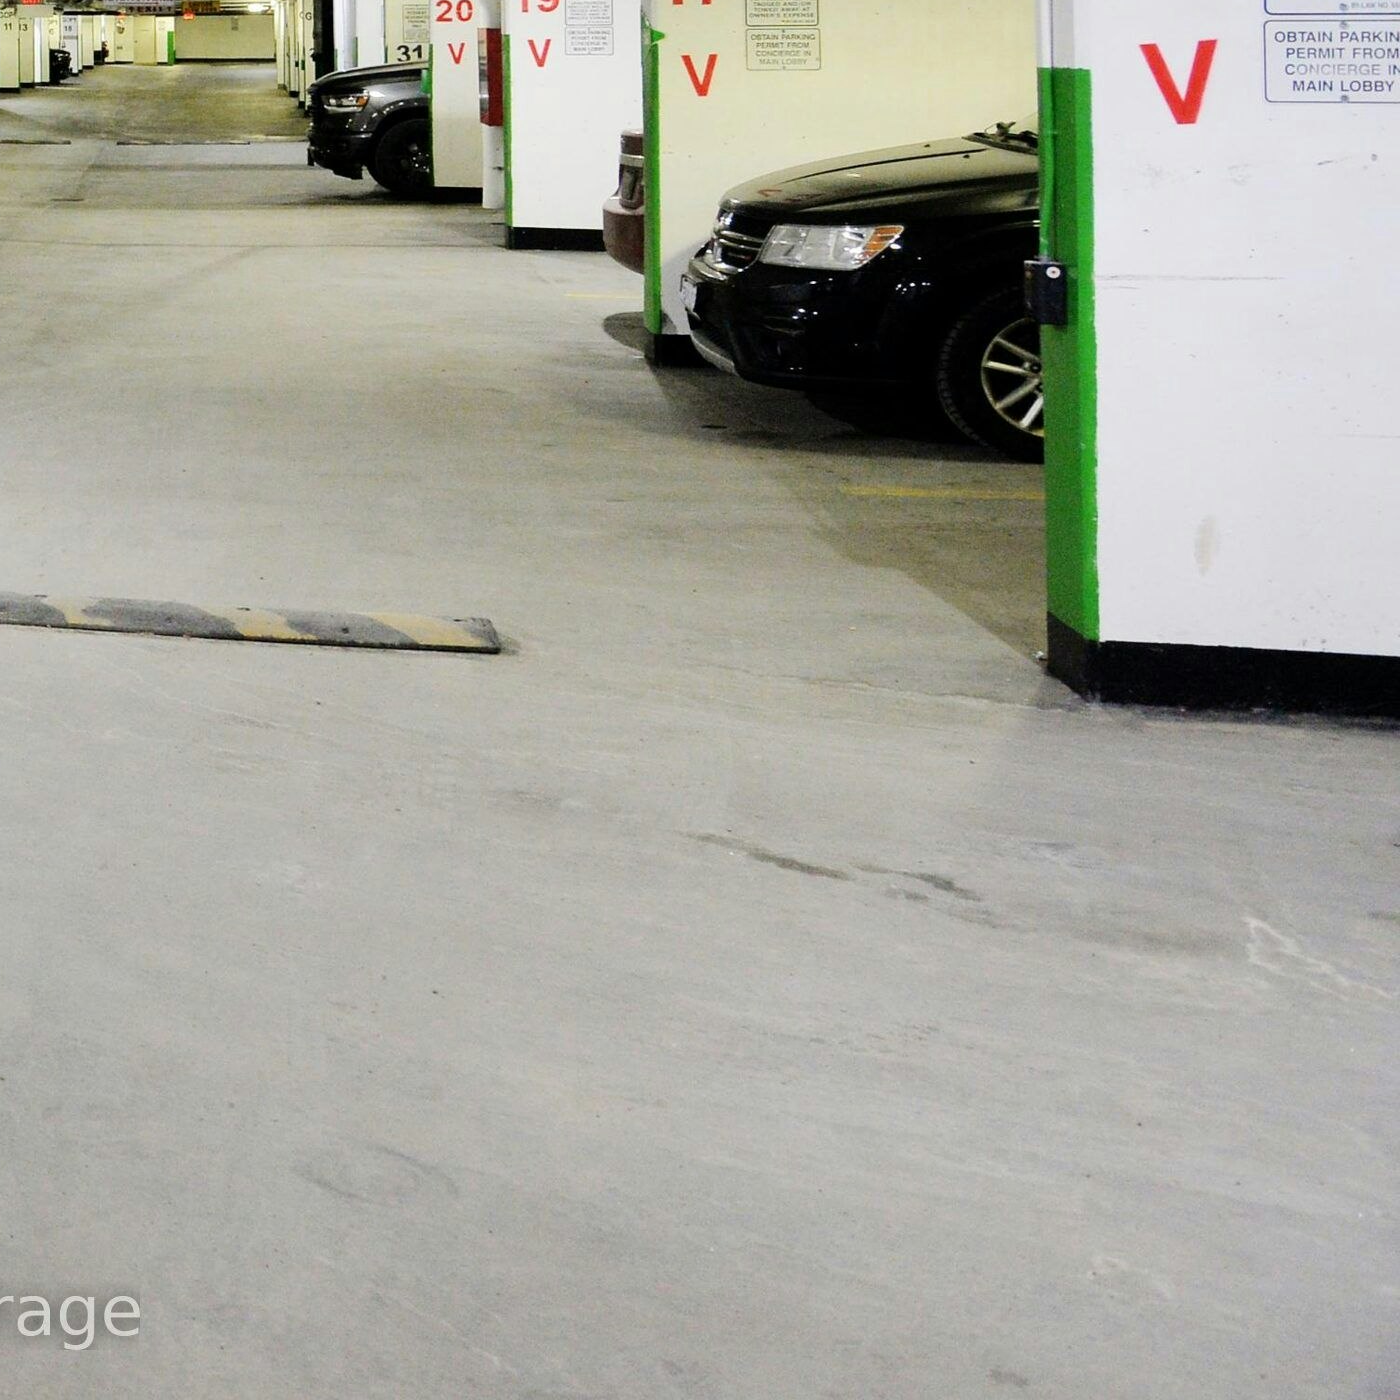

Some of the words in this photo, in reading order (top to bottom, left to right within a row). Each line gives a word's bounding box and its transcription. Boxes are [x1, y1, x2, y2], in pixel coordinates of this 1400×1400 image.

[435, 0, 473, 22] 20
[1274, 31, 1333, 43] OBTAIN
[1340, 31, 1400, 42] PARKIN
[396, 45, 422, 62] 31
[447, 42, 465, 65] V
[528, 39, 551, 68] V
[1286, 48, 1345, 59] PERMIT
[1353, 48, 1399, 59] FROM
[681, 54, 718, 97] V
[1285, 64, 1381, 75] CONCIERGE
[1140, 39, 1218, 125] V
[1293, 81, 1333, 92] MAIN
[1341, 81, 1394, 92] LOBBY
